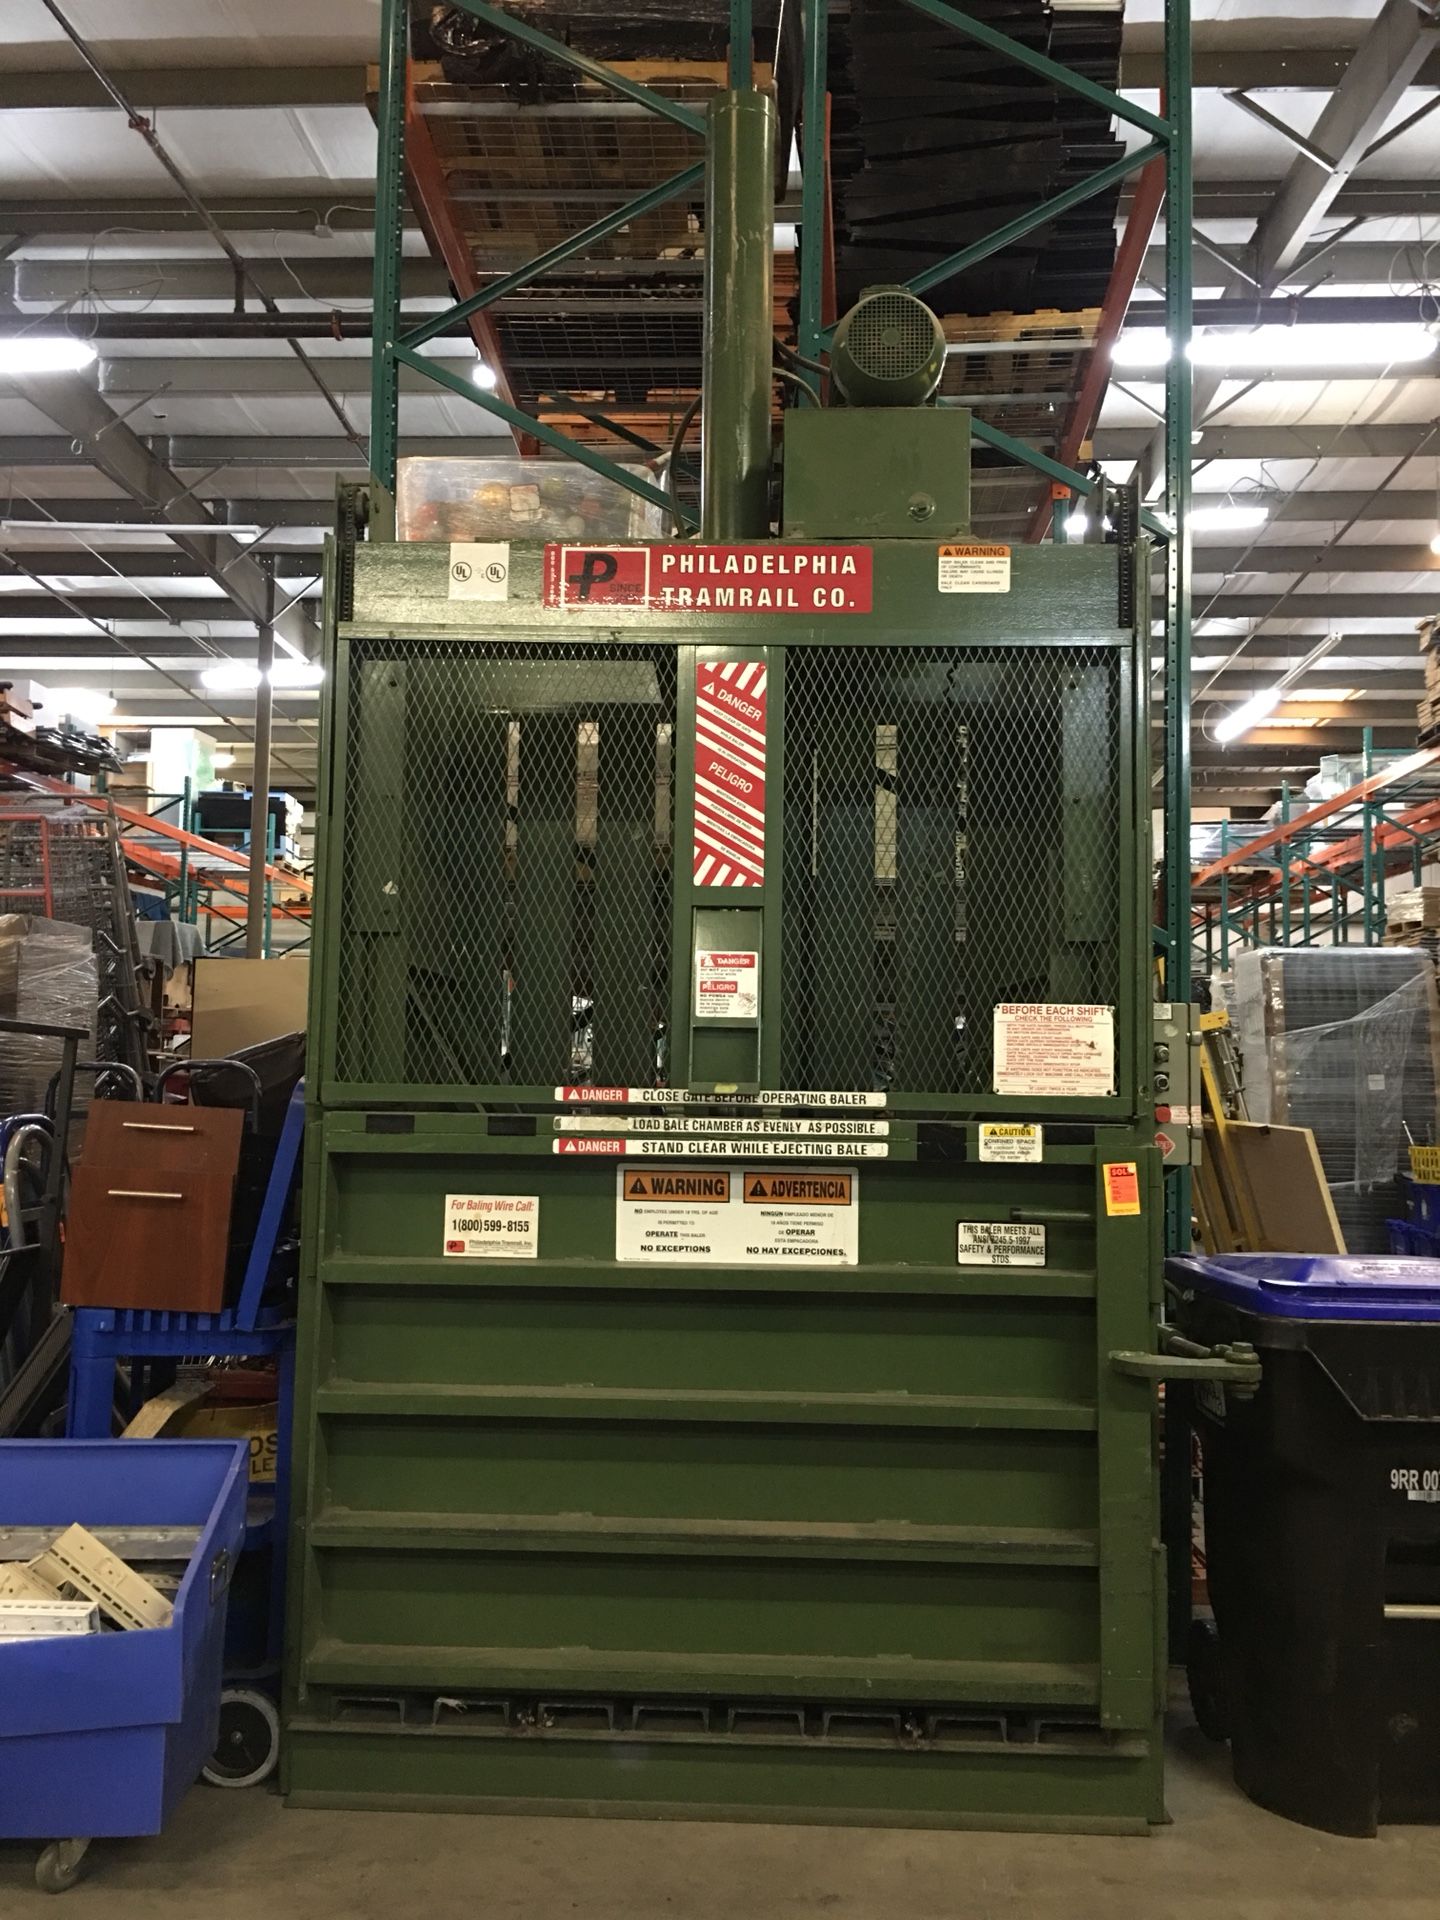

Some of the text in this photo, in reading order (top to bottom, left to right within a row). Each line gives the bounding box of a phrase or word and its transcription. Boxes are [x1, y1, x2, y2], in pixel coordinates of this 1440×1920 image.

[955, 547, 1005, 556] WARNING
[661, 554, 856, 574] PHILADELPHIA
[609, 583, 641, 592] SINCE
[661, 587, 855, 607] TRAMRAIL CO.
[717, 688, 762, 721] DANGER
[708, 761, 753, 794] PELIGRO
[716, 957, 750, 965] DANGER
[702, 983, 736, 991] PELIGRO
[1001, 1005, 1105, 1016] BEFORE EACH SHIFT
[1054, 1015, 1093, 1023] FOLLOWING
[582, 1089, 623, 1101] DANGER
[643, 1090, 679, 1102] CLOSE
[762, 1092, 826, 1104] OPERATING
[830, 1094, 867, 1105] BALER
[633, 1119, 876, 1134] LOAD BALE CHAMBER AS EVENLY AS POSSIBLE
[999, 1128, 1032, 1136] CAUTION
[578, 1141, 868, 1155] DANGER STAND CLEAR WHILE EJECTING BALE
[651, 1178, 725, 1196] WARNING
[771, 1180, 846, 1199] ADVERTENCIA
[451, 1199, 535, 1213] For Baling Wire Call:
[645, 1230, 678, 1238] OPERATE
[785, 1228, 816, 1236] OPERAR
[963, 1225, 1041, 1236] THIS BALER MEETS ALL
[656, 1245, 711, 1253] EXCEPTIONS
[746, 1246, 847, 1256] NO HAY EXCEPCIONES.
[959, 1244, 1045, 1255] SAFETY & PERFORMANCE
[991, 1254, 1012, 1264] STDS.
[1390, 1469, 1440, 1490] 9RR 00
